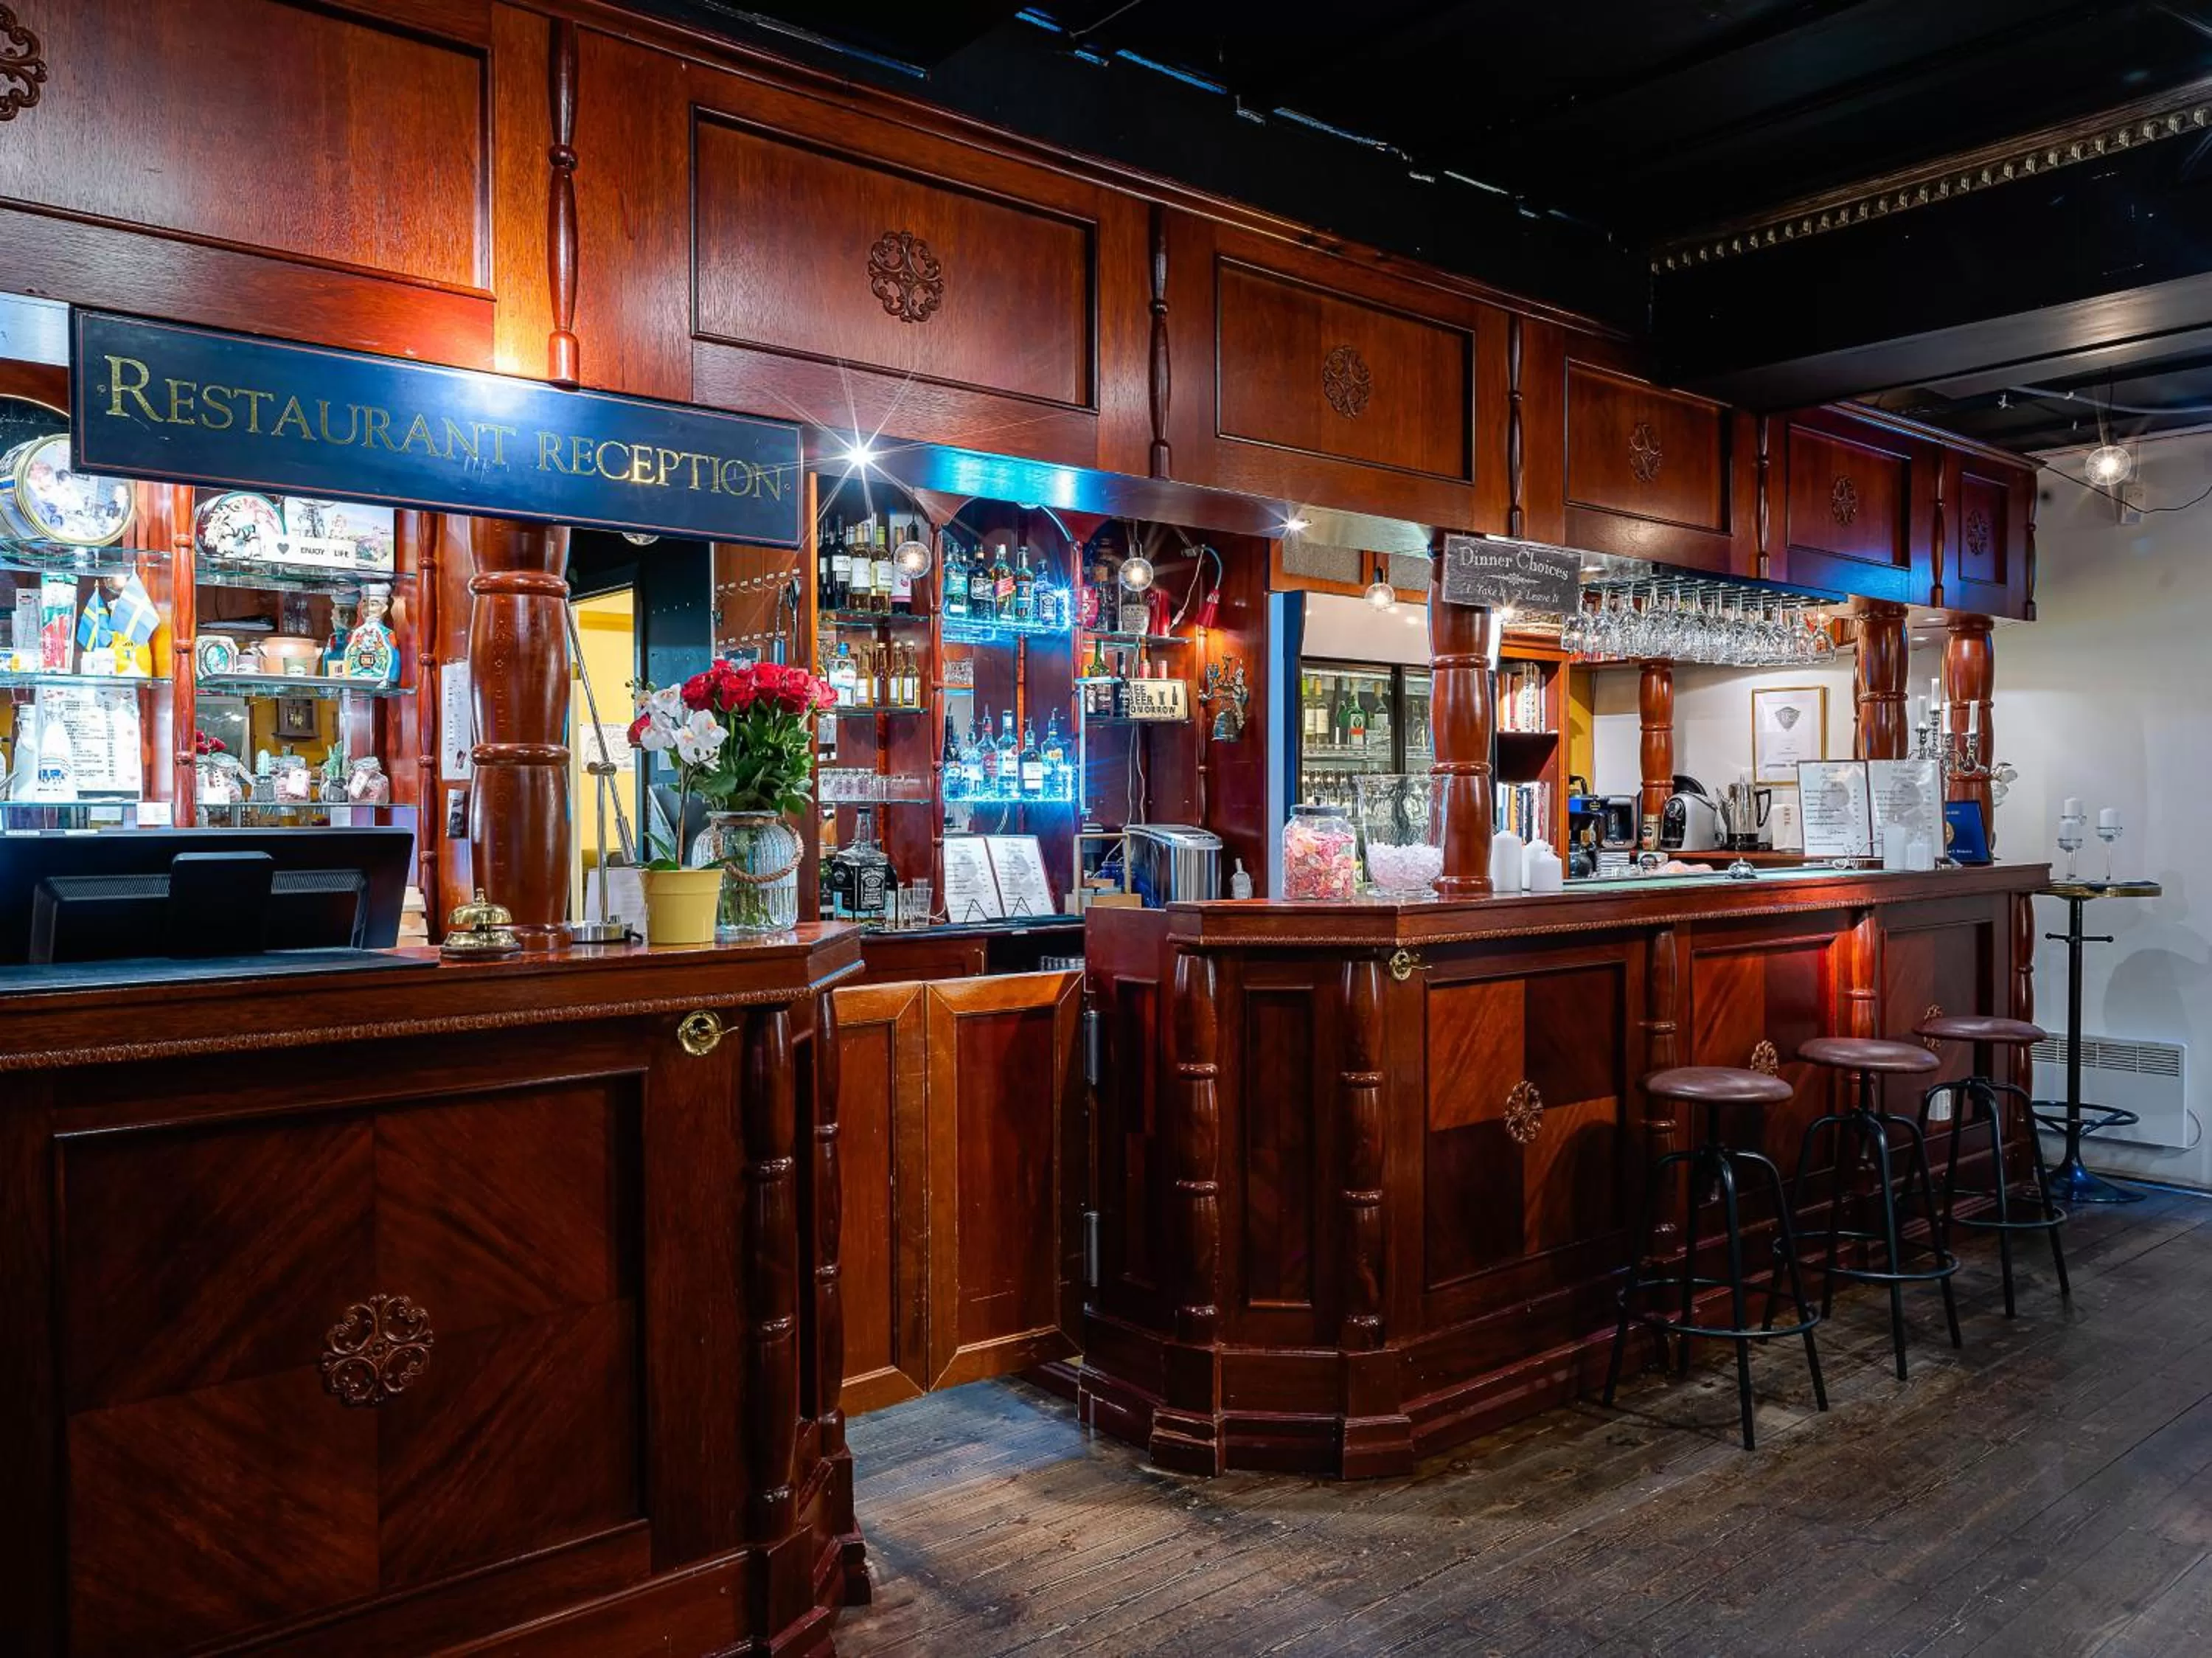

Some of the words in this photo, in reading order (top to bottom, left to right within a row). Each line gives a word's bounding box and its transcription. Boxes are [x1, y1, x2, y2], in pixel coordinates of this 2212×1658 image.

[104, 354, 517, 466] RESTAURANT
[536, 430, 782, 501] RECEPTION
[300, 547, 325, 555] ENJOY
[334, 549, 350, 558] LIFE
[1458, 546, 1513, 567] Dinner
[1516, 549, 1569, 580] Choices
